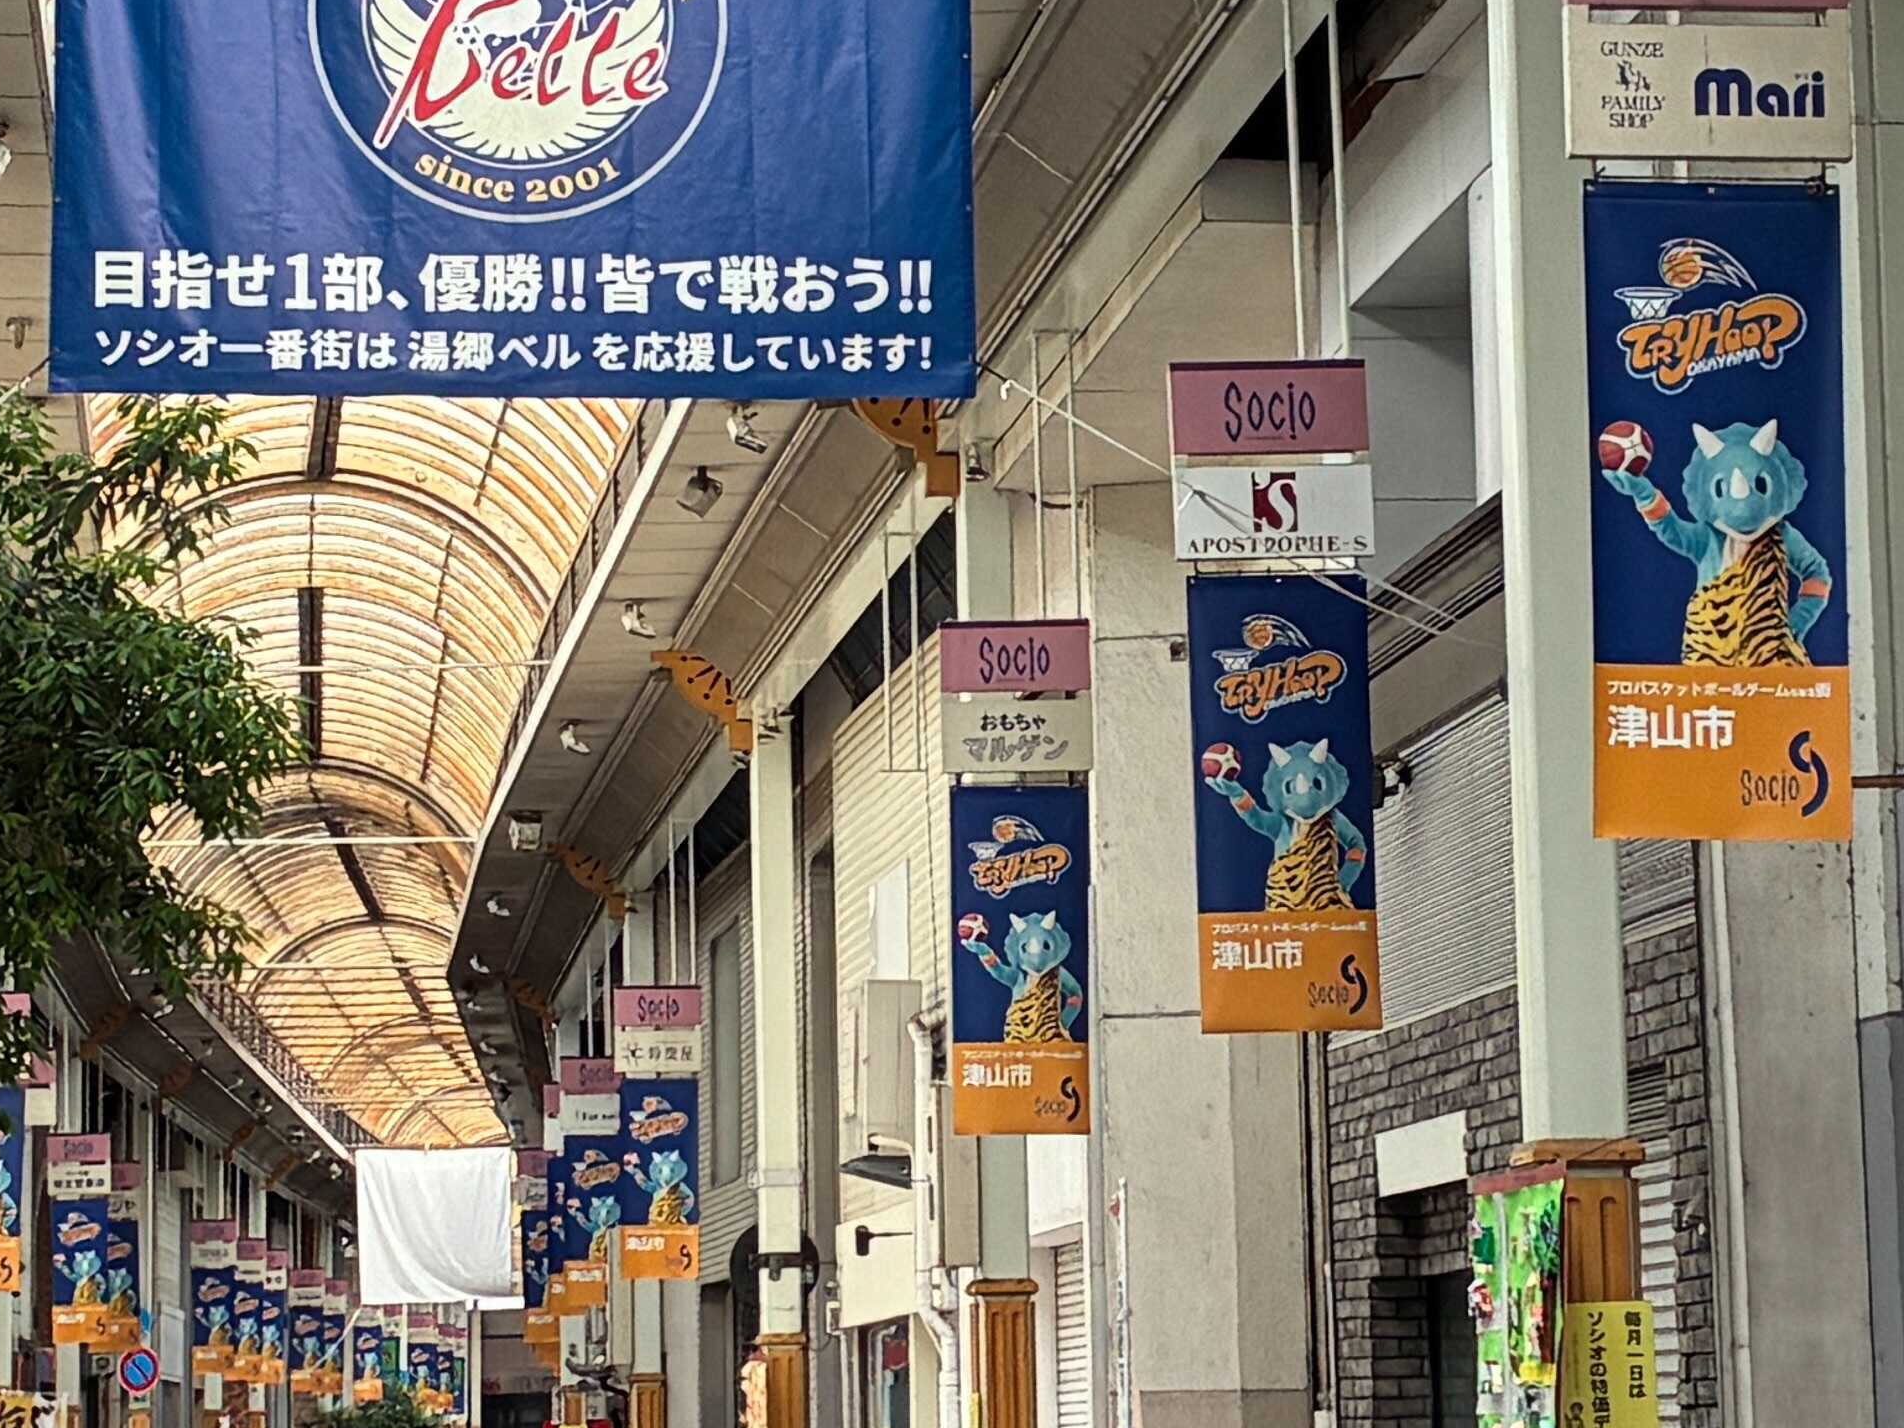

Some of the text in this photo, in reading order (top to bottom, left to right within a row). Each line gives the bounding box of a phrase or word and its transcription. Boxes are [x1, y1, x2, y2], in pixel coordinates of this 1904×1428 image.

[1600, 41, 1664, 59] GUNZE
[1601, 95, 1665, 112] FAMILY
[1609, 113, 1655, 129] SHOP
[415, 153, 622, 203] since 2001
[1224, 381, 1316, 442] Socio
[980, 636, 1050, 684] Socio
[980, 712, 1047, 732] おもちゃ
[1608, 704, 1736, 749] 津山市
[1211, 938, 1304, 970] 津山市
